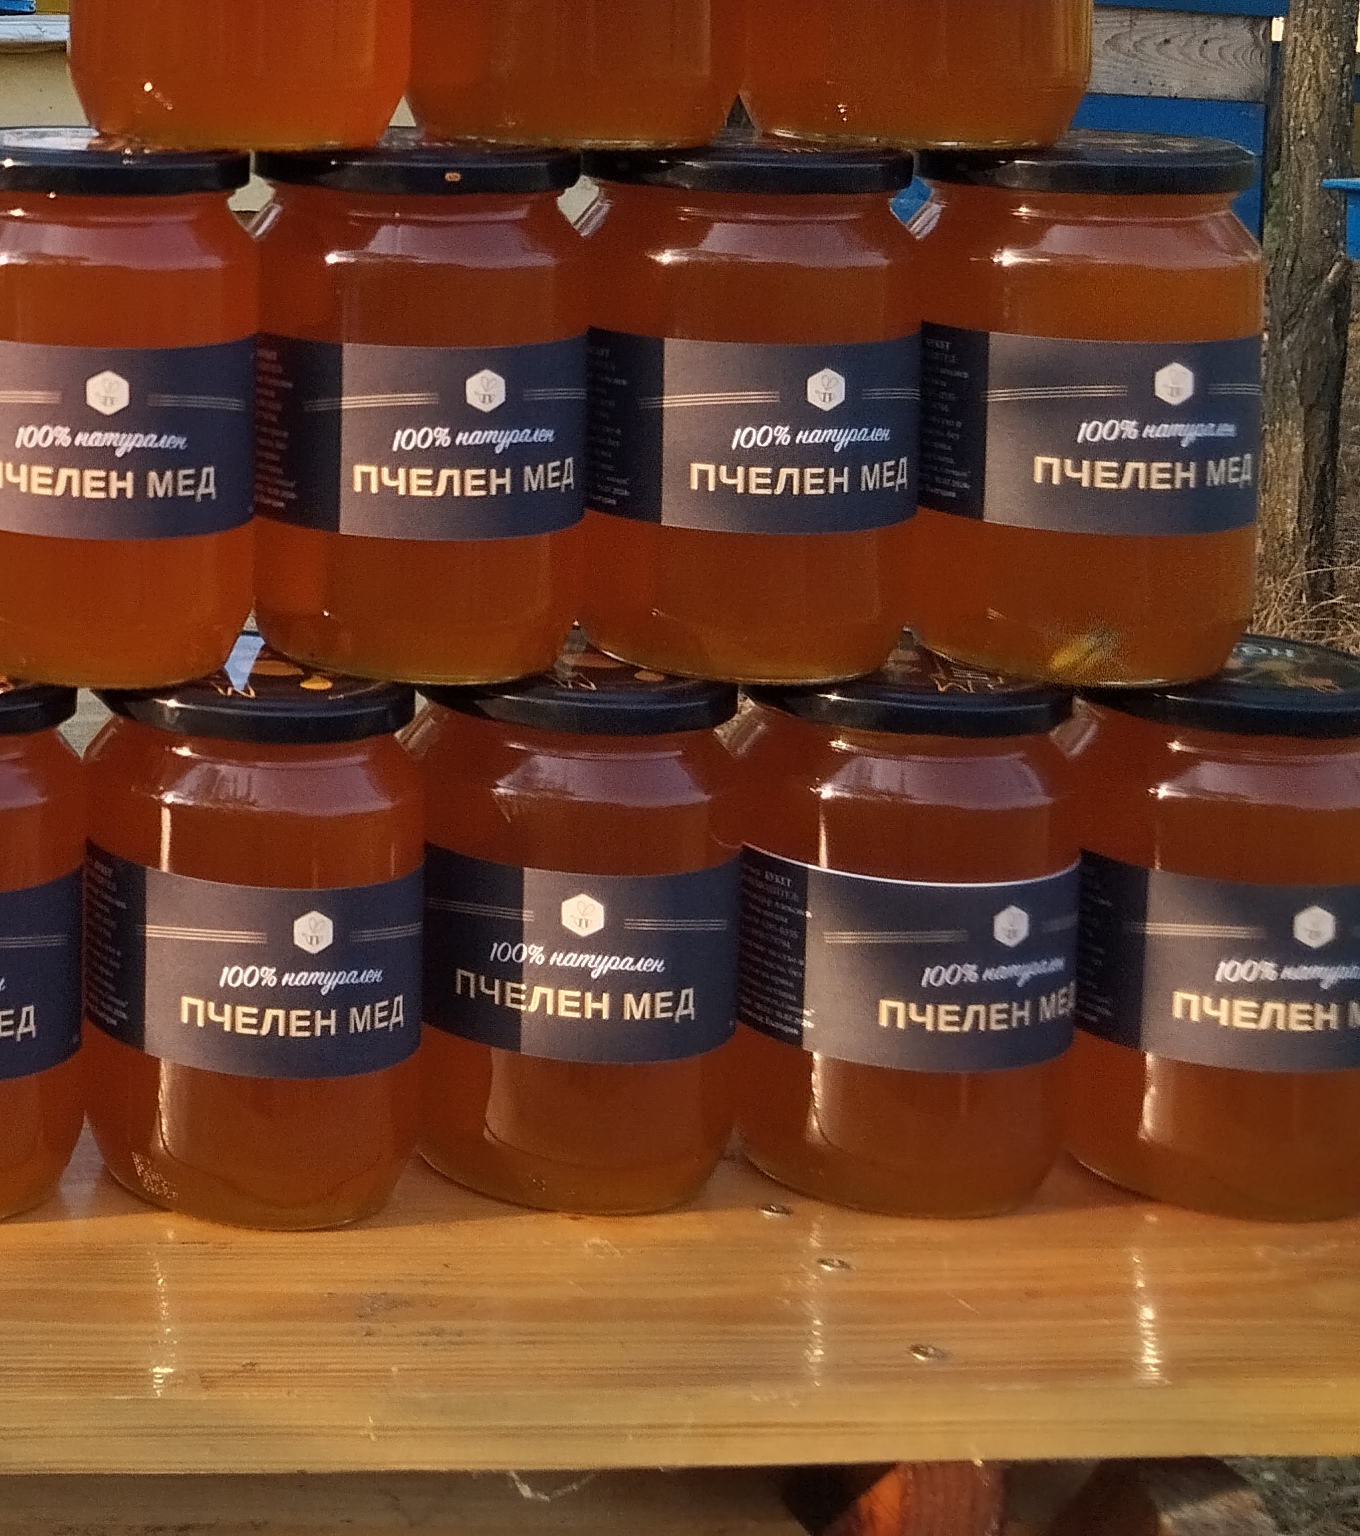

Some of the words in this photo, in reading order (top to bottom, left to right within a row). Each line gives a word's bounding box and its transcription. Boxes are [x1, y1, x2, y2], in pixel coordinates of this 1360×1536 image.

[16, 424, 72, 449] 100%
[75, 431, 188, 457] натурален
[393, 427, 451, 452] 100%
[455, 427, 556, 454] натурален
[732, 425, 790, 450] 100%
[796, 426, 891, 452] натурален
[1077, 419, 1139, 444] 100%
[147, 466, 216, 502] МЕД
[353, 464, 512, 497] ПЧЕЛЕН
[523, 456, 574, 493] МЕД
[690, 462, 849, 496] ПЧЕЛЕН
[861, 456, 908, 492] МЕД
[1034, 456, 1196, 490] ПЧЕЛЕН
[1206, 453, 1253, 488] МЕД
[490, 941, 545, 964] 100%
[549, 951, 666, 979] натурален
[921, 963, 979, 988] 100%
[1215, 959, 1279, 983] 100%
[219, 965, 277, 988] 100%
[281, 967, 383, 995] натурален
[455, 968, 610, 1020] ПЧЕЛЕН
[624, 988, 696, 1023] МЕД
[180, 995, 336, 1037] ПЧЕЛЕН
[349, 994, 405, 1034] МЕД
[879, 999, 1030, 1032] ПЧЕЛЕН
[1172, 991, 1339, 1031] ПЧЕЛЕН
